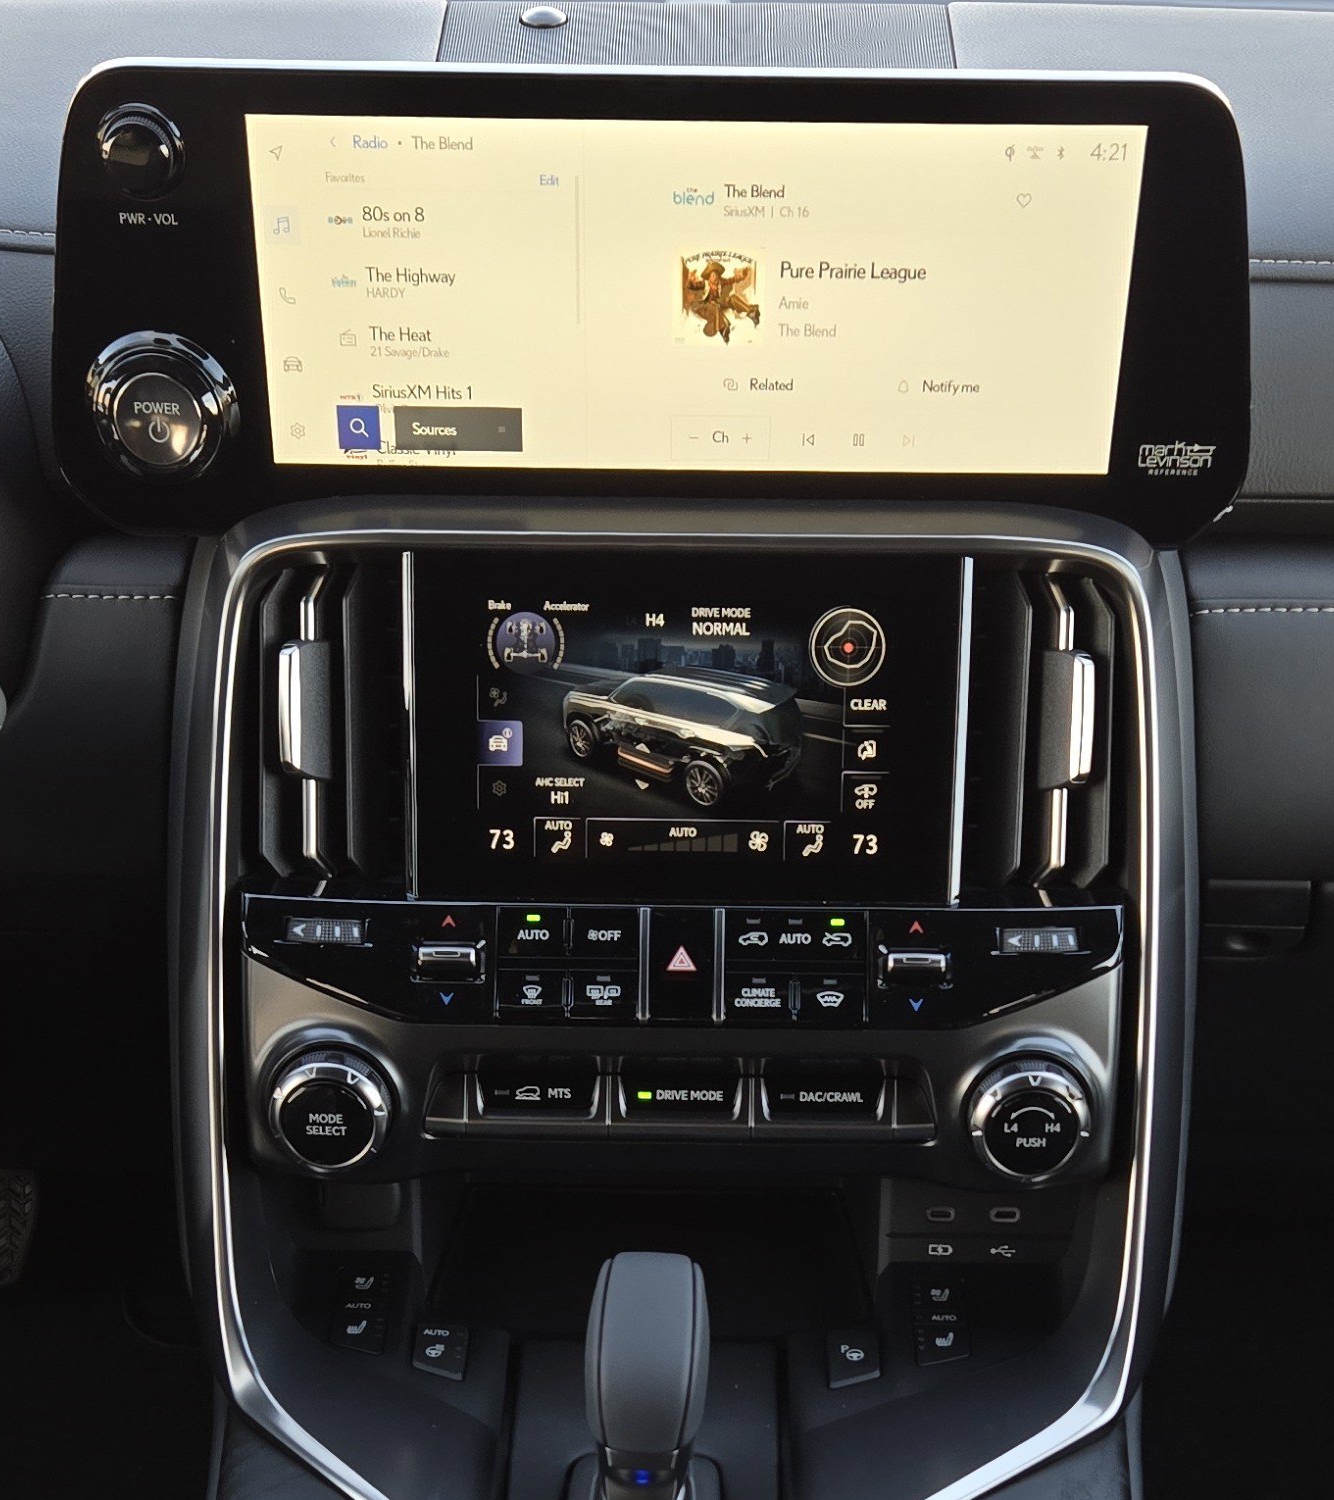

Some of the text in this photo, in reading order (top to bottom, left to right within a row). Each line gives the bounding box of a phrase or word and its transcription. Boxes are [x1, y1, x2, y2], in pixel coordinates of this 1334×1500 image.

[352, 135, 473, 151] Radio The Blend
[1090, 142, 1128, 161] 4:21
[324, 171, 366, 184] Favorites
[539, 174, 560, 187] Edit
[723, 183, 785, 199] The Blend
[672, 191, 715, 205] blend
[362, 205, 390, 222] 80s
[393, 210, 412, 222] on
[414, 206, 426, 222] 8
[723, 205, 810, 219] SiriusXM Ch 16
[119, 212, 178, 226] PWR VOL
[362, 226, 421, 240] Lionel Richie
[365, 266, 393, 283] The
[396, 267, 456, 287] Highway
[779, 260, 927, 284] Pure Prairie League
[366, 287, 406, 299] HARDY
[778, 296, 809, 311] Amie
[368, 326, 432, 343] The Heat
[778, 323, 837, 338] The Blend
[370, 346, 450, 360] 21 Savage/Drake
[749, 377, 794, 391] Related
[922, 379, 980, 396] Notify me
[372, 383, 432, 400] SiriusXM
[435, 385, 463, 401] Hits
[466, 385, 473, 400] 1
[133, 402, 181, 416] POWER
[412, 422, 458, 437] Sources
[712, 430, 729, 444] Ch
[487, 599, 512, 611] Brake
[542, 600, 590, 612] Accelerator
[691, 606, 752, 619] DRIVE MODE
[645, 613, 665, 628] H4
[691, 621, 751, 637] NORMAL
[849, 698, 888, 711] CLEAR
[535, 778, 585, 788] AHC SELECT
[855, 798, 876, 810] OFF
[544, 821, 573, 832] AUTO
[668, 827, 698, 838] AUTO
[796, 824, 825, 835] AUTO
[489, 829, 515, 850] 73
[852, 834, 879, 855] 73
[517, 929, 550, 940] AUTO
[598, 930, 622, 941] OFF
[778, 933, 812, 945] AUTO
[741, 988, 776, 998] CLIMATE
[734, 998, 782, 1008] CONCIERGE
[547, 1087, 572, 1099] MTS
[655, 1089, 724, 1102] DRIVE MODE
[799, 1091, 864, 1103] DAC/CRAWL
[308, 1113, 344, 1125] MODE
[305, 1125, 348, 1136] SELECT
[1003, 1122, 1019, 1133] L4
[1044, 1122, 1061, 1133] H4
[1015, 1137, 1047, 1148] PUSH
[423, 1328, 450, 1337] AUTO
